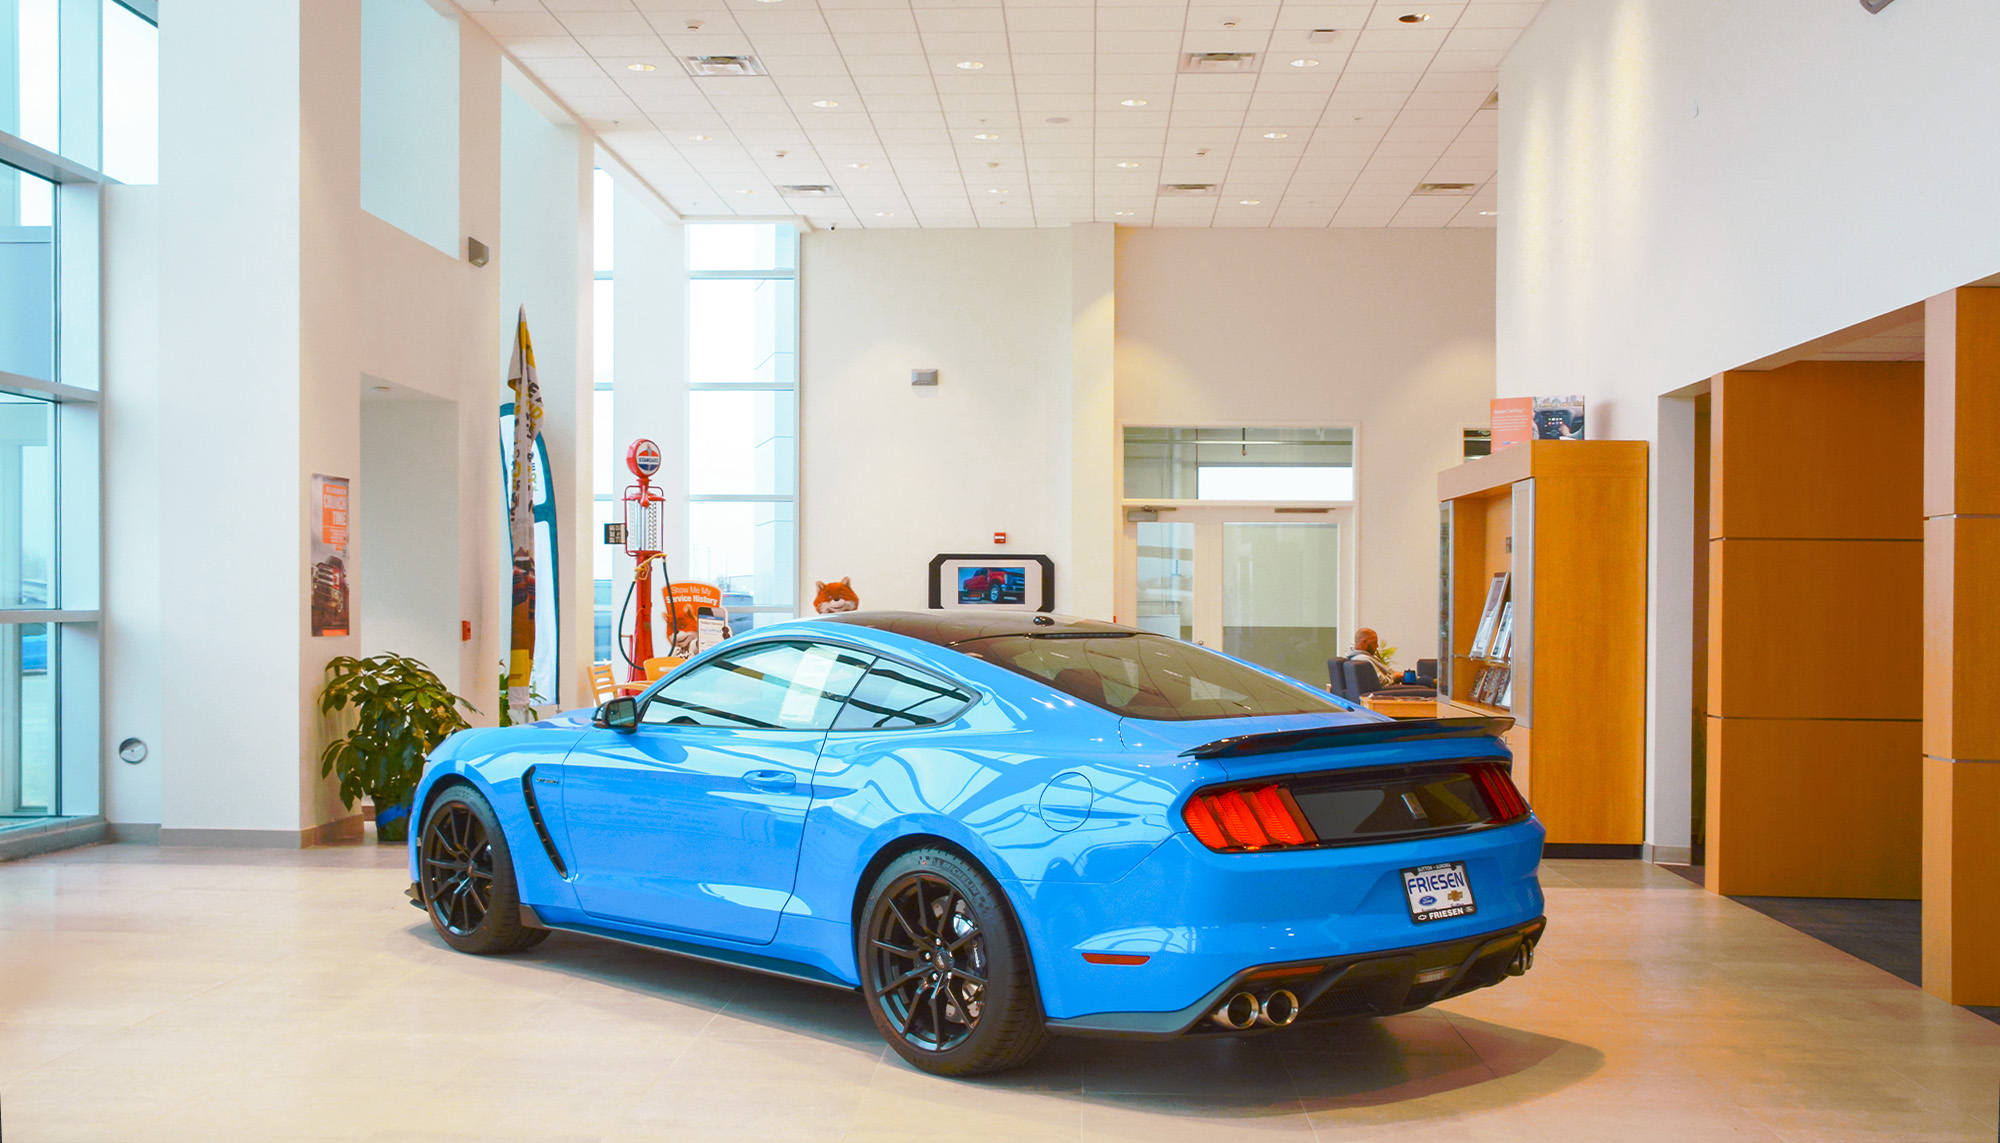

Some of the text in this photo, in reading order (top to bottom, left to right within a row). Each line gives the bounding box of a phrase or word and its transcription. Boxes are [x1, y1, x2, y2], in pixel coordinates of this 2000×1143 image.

[332, 510, 347, 526] TIME
[701, 587, 711, 596] My
[693, 595, 718, 606] History
[942, 862, 979, 896] MICHELIN
[1408, 872, 1465, 894] FRIESEN
[1429, 907, 1464, 920] FRIESEN
